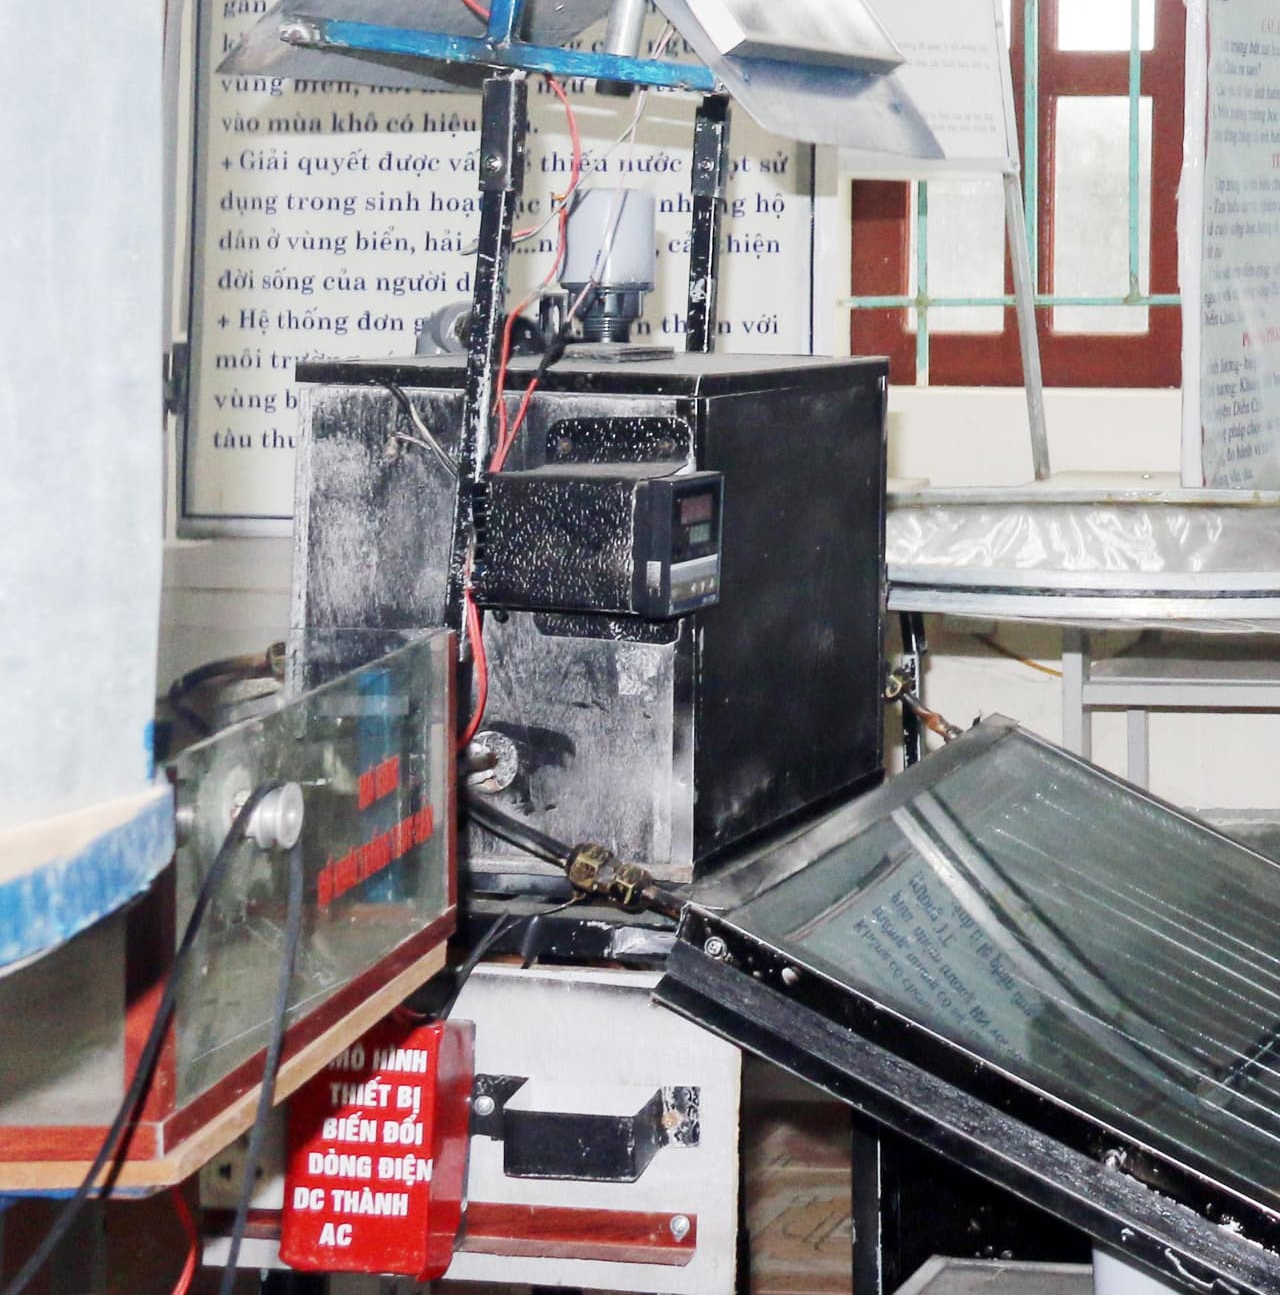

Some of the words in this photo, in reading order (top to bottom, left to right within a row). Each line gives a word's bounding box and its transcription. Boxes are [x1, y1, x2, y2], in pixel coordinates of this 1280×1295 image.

[373, 1042, 428, 1073] HÌNH
[330, 1076, 391, 1107] THIẾT
[397, 1086, 421, 1114] BỊ
[322, 1111, 376, 1143] BIẾN
[383, 1114, 423, 1145] ĐỔI
[308, 1147, 372, 1178] DÒNG
[378, 1153, 433, 1186] ĐIỆN
[293, 1186, 325, 1210] DC
[331, 1187, 408, 1217] THÀNH
[318, 1222, 352, 1246] AC
